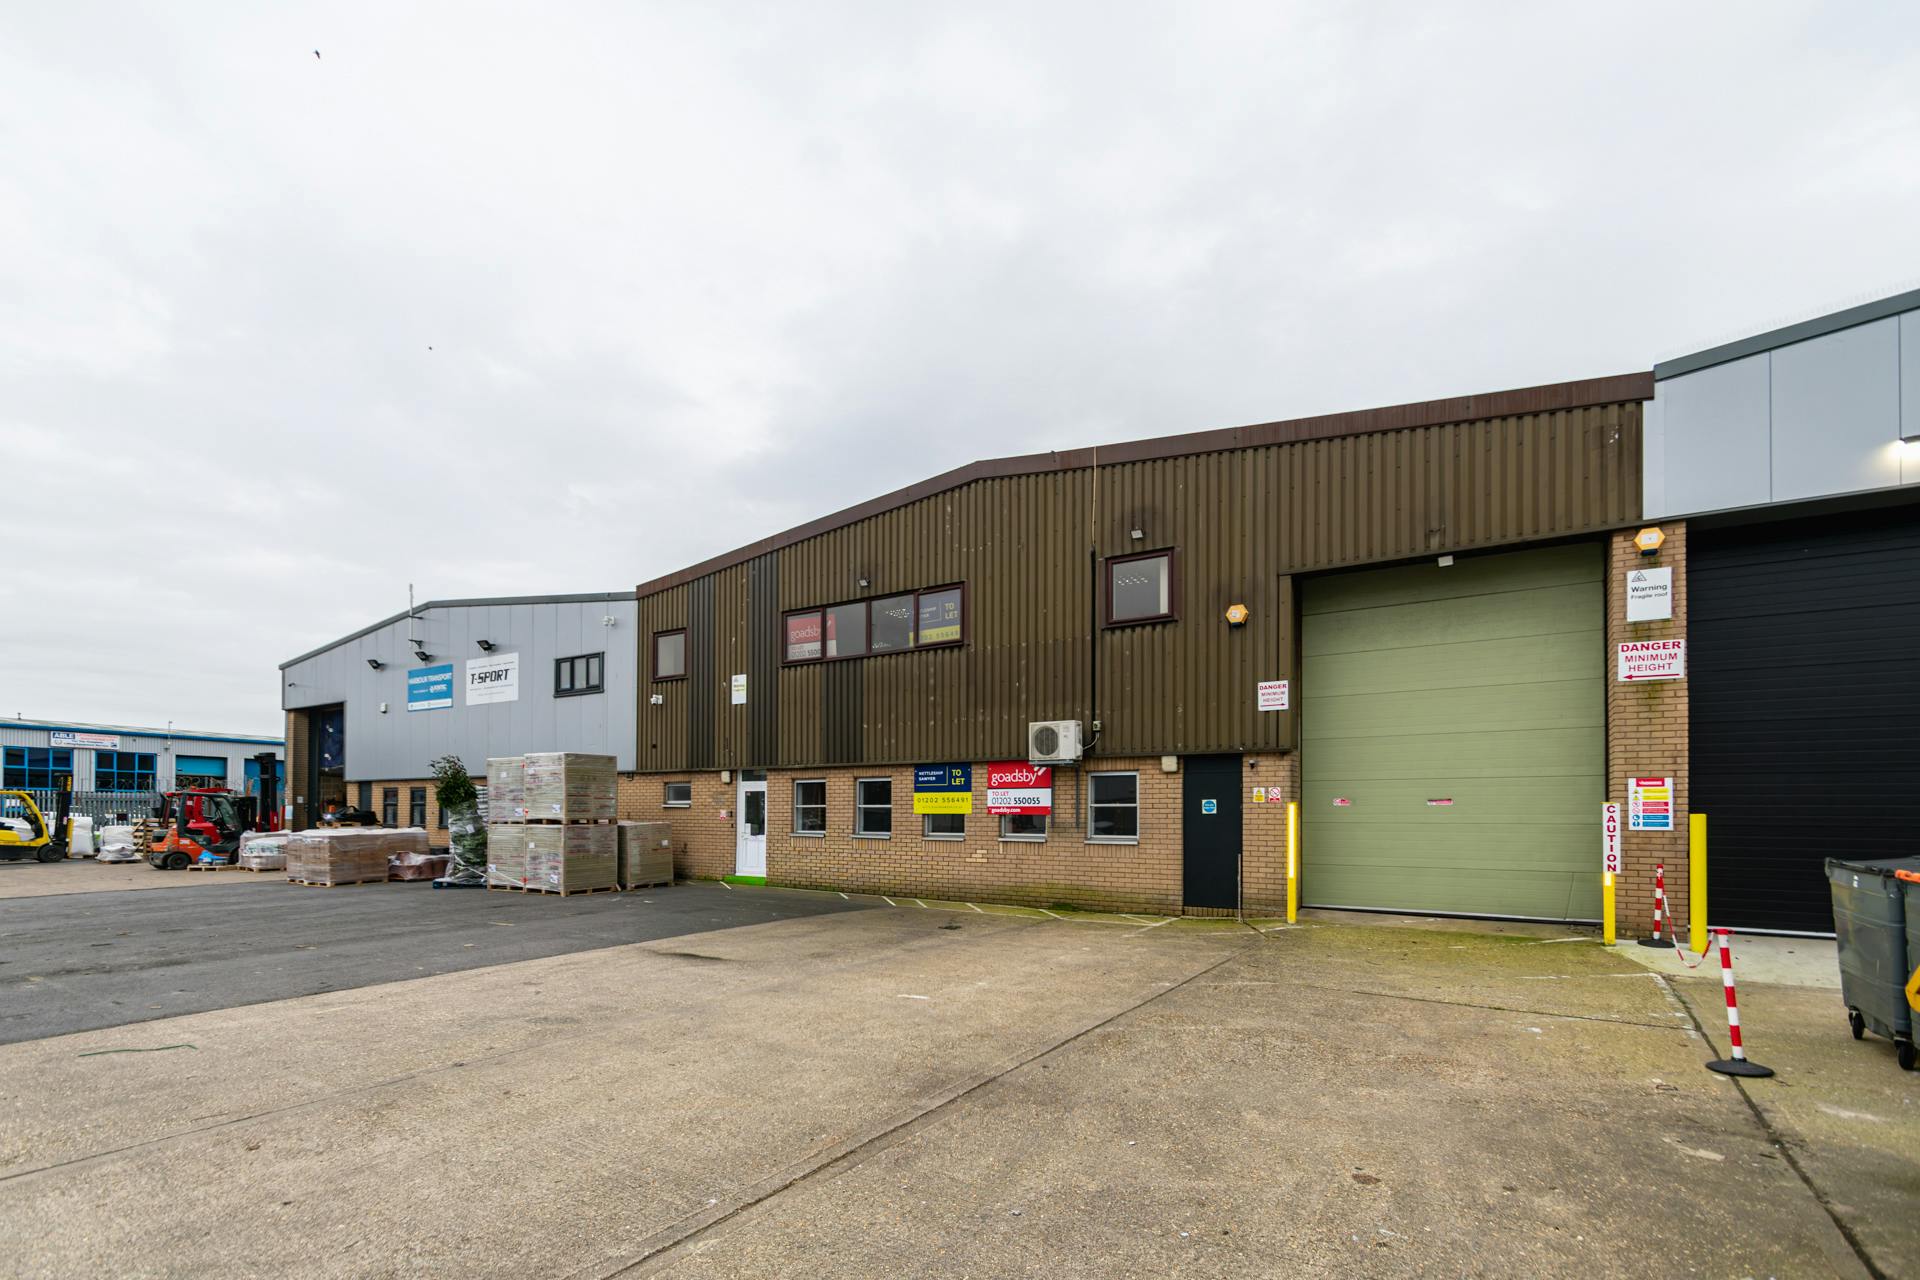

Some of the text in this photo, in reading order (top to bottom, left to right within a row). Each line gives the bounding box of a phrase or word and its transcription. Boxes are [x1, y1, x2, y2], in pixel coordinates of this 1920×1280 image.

[1631, 584, 1668, 593] Warning
[944, 602, 955, 610] TO
[945, 610, 958, 619] LET
[790, 623, 821, 642] goadsb
[1621, 641, 1681, 652] DANGER
[1625, 652, 1678, 663] MINIMUM
[1628, 662, 1673, 672] HEIGHT
[470, 668, 510, 684] T-SPORT
[951, 768, 962, 776] TO
[991, 769, 1036, 786] goadsby
[991, 796, 1041, 805] 01202 550055
[1606, 805, 1617, 872] CAUTION
